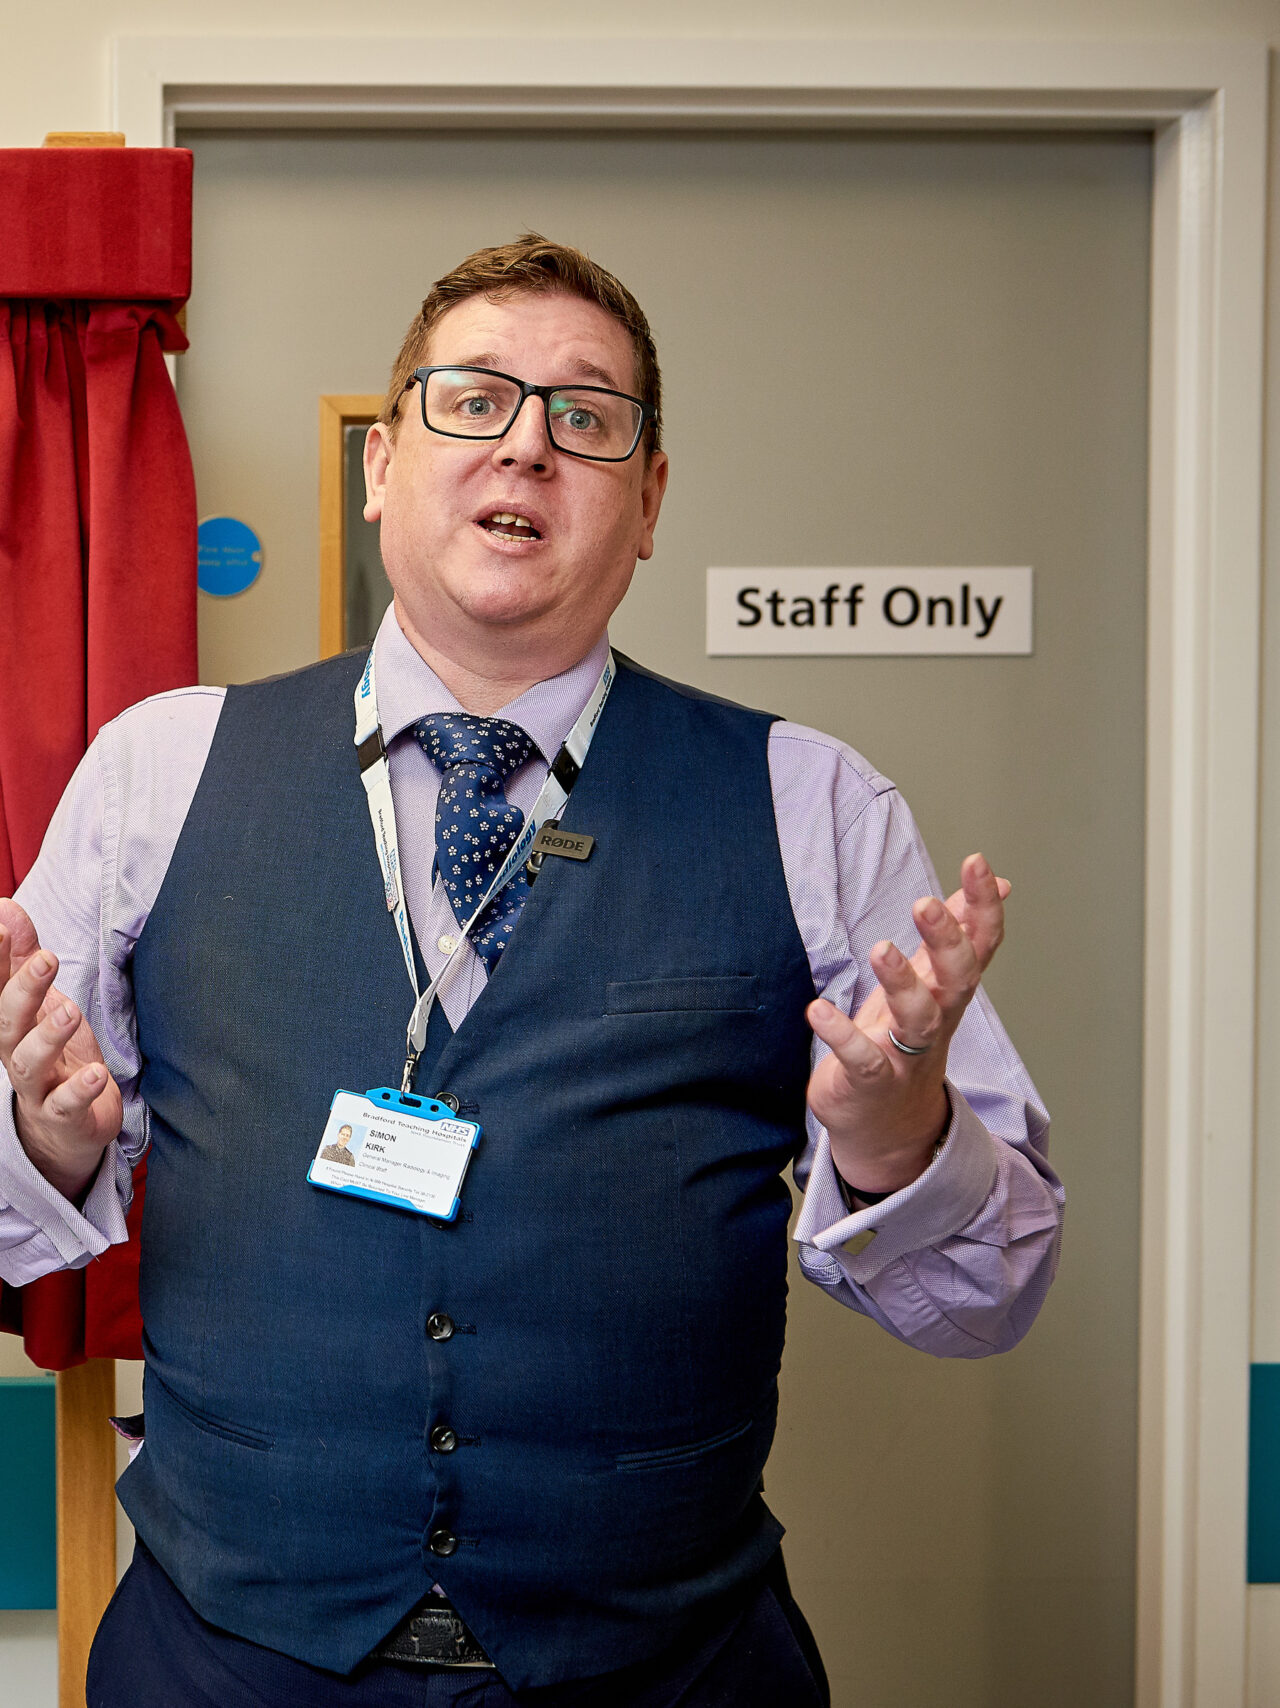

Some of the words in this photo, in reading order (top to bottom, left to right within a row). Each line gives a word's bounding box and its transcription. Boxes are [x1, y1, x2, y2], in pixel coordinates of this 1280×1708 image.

[736, 584, 865, 628] Staff
[882, 583, 1004, 639] Only
[540, 835, 585, 852] RØDE
[362, 1112, 396, 1126] Bradford
[398, 1121, 430, 1135] Teaching
[431, 1129, 467, 1143] Hospitals
[441, 1122, 470, 1137] NHS
[369, 1129, 398, 1143] SIMON
[365, 1142, 387, 1154] KIRK
